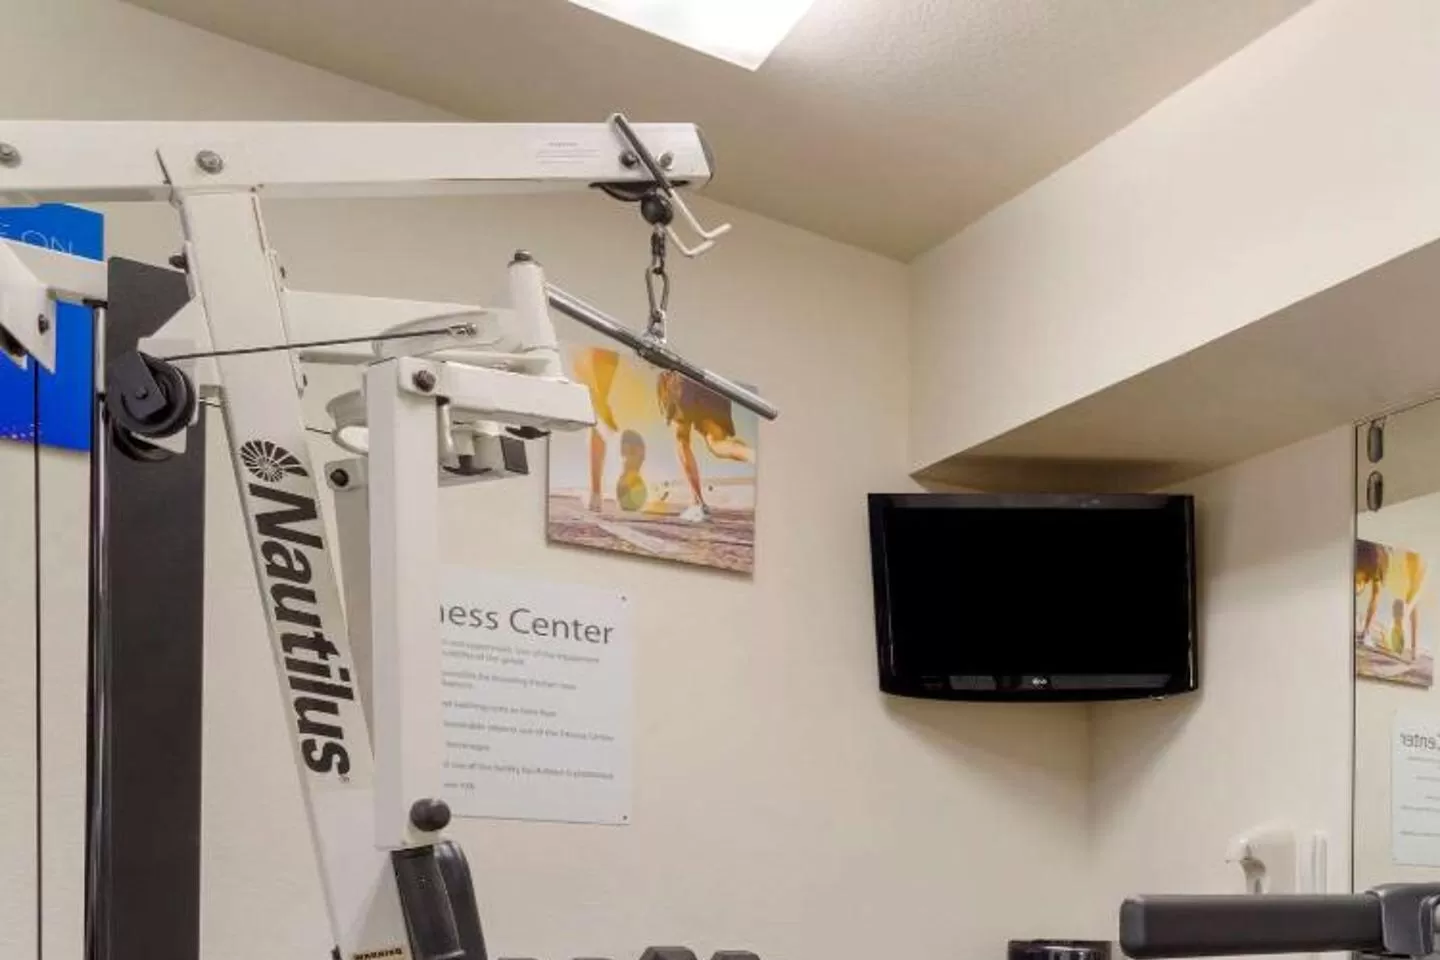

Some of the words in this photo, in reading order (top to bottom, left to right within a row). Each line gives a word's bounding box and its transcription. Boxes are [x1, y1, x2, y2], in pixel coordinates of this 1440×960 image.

[248, 482, 354, 775] Nautilus
[509, 607, 616, 645] Center
[353, 947, 402, 960] WARNING
